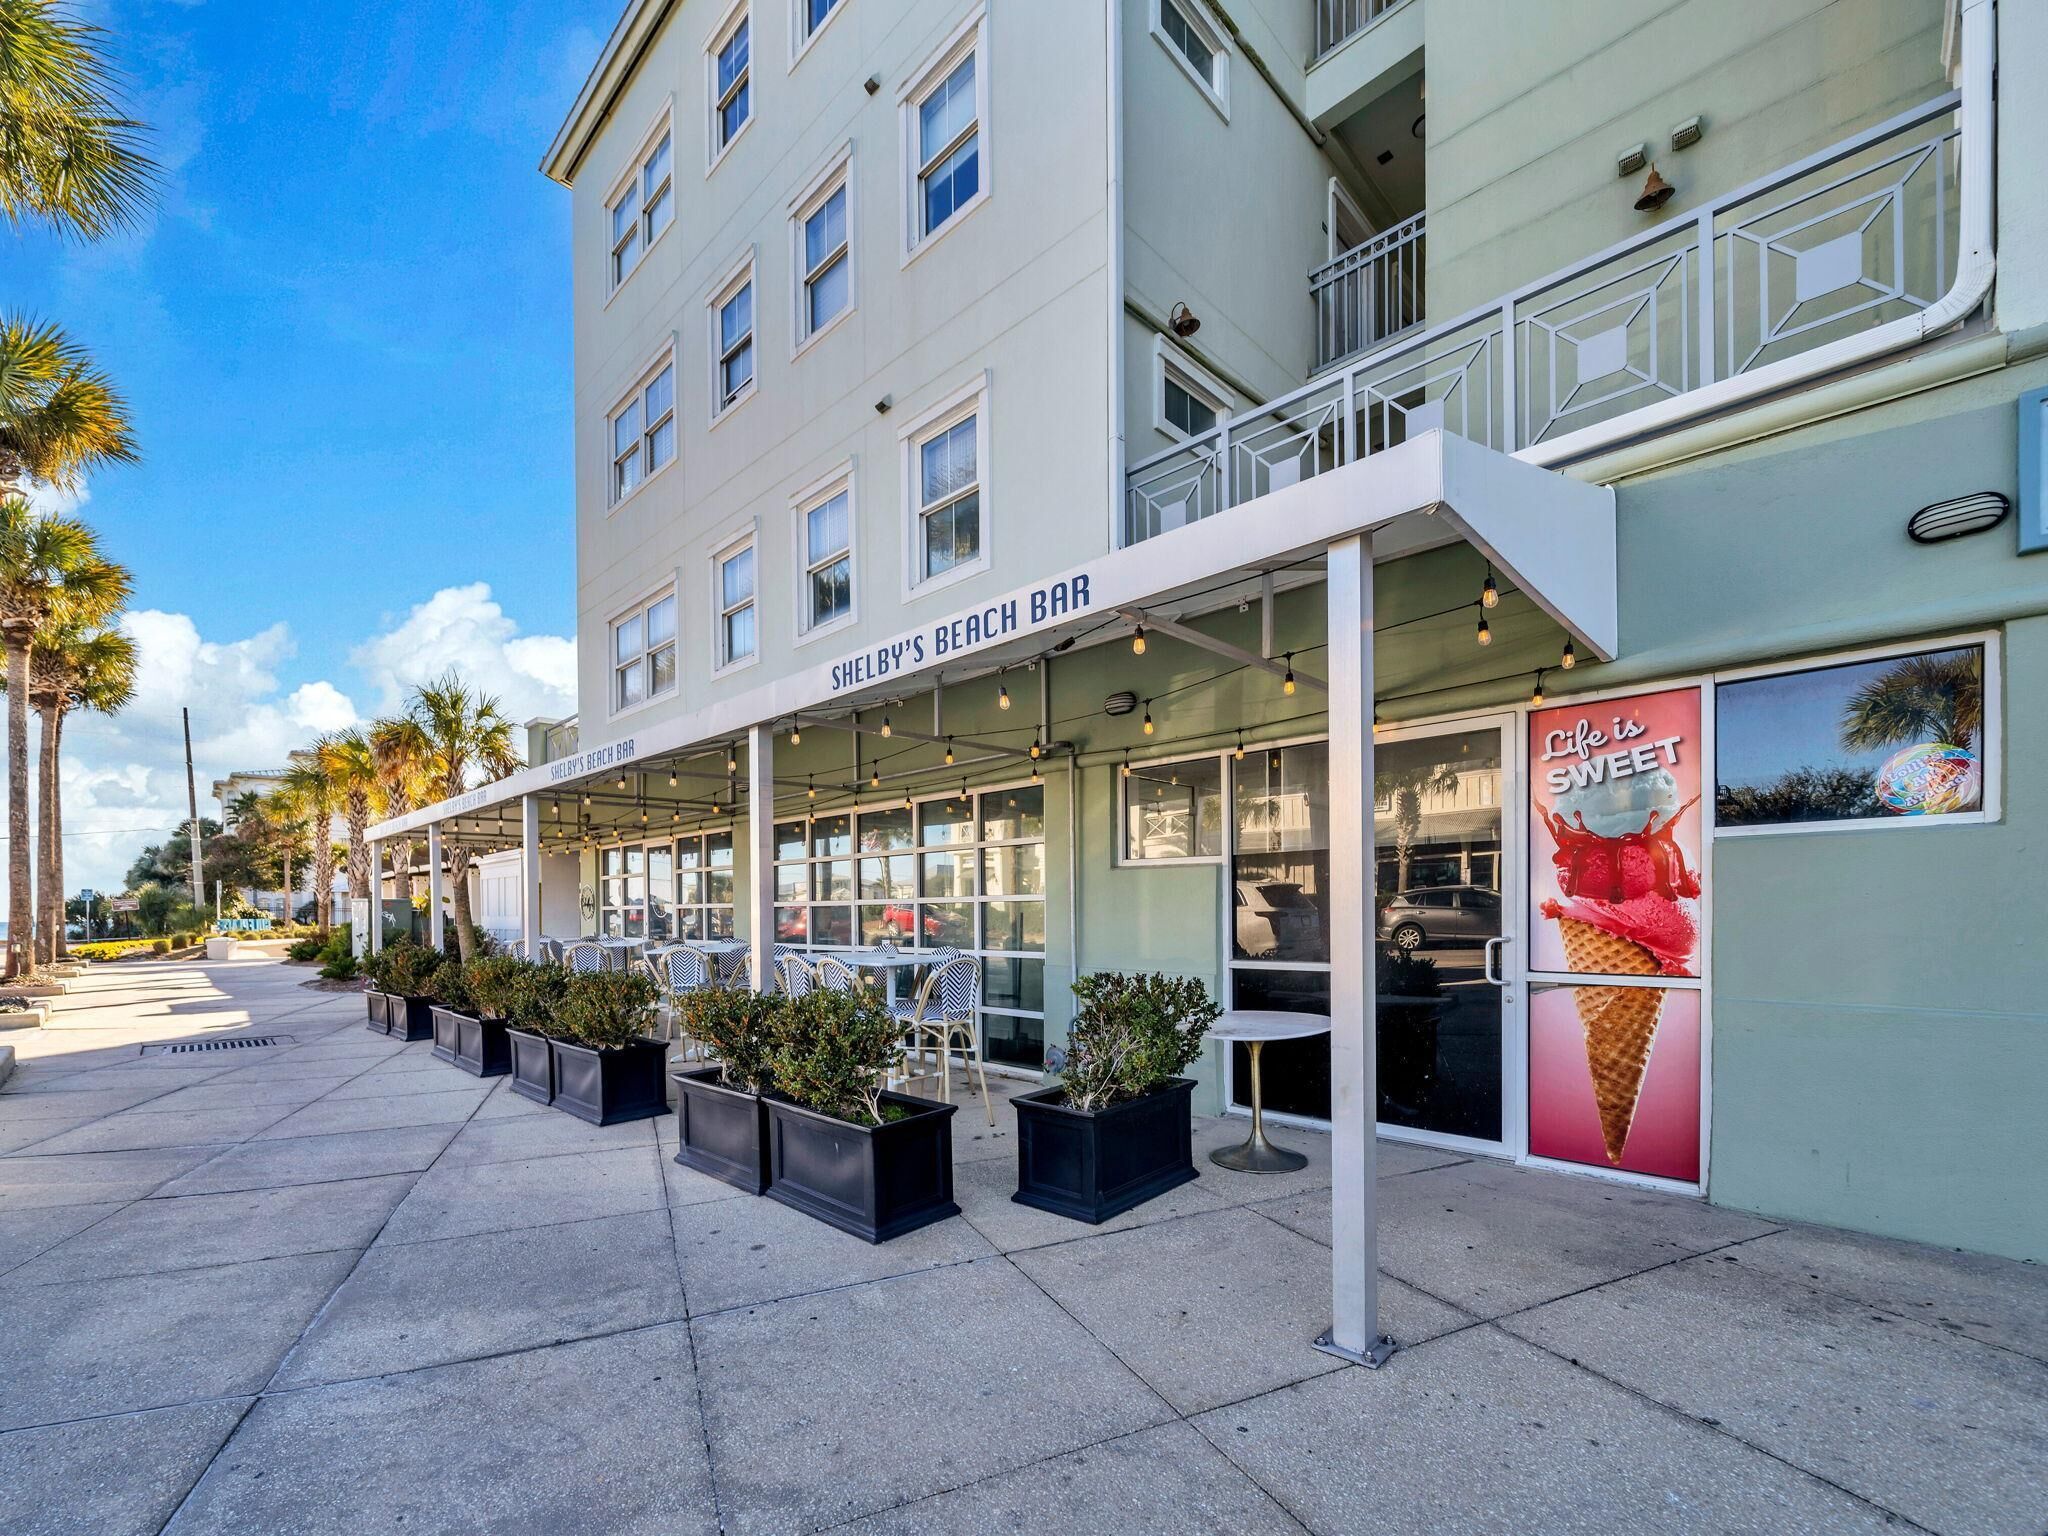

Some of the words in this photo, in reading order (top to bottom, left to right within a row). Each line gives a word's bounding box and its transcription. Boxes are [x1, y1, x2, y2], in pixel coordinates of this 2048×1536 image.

[832, 635, 924, 690] SHELBY'S
[936, 600, 1016, 656] BEACH
[1031, 574, 1090, 624] BAR
[551, 757, 584, 781] SHELBY'S
[587, 746, 613, 770] BEACH
[617, 739, 635, 760] BAR
[1541, 718, 1608, 761] Life
[1612, 716, 1645, 740] is
[1546, 736, 1681, 794] SWEET
